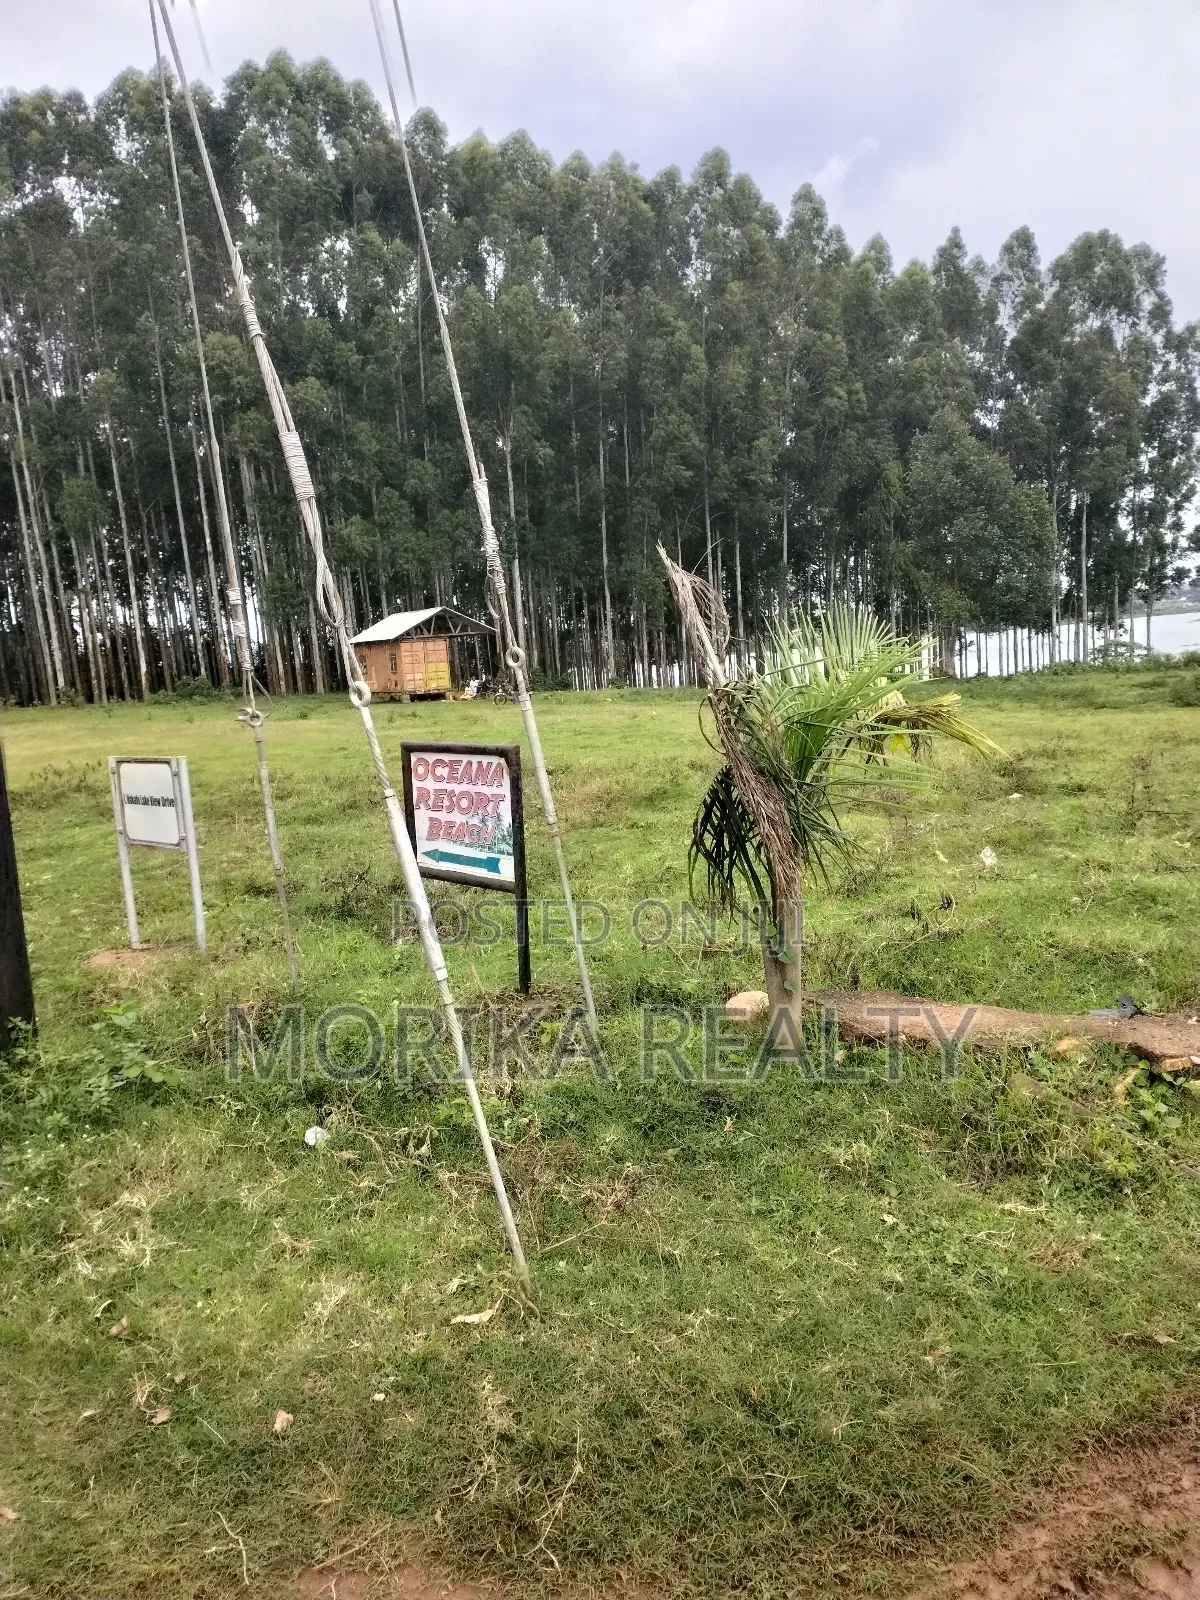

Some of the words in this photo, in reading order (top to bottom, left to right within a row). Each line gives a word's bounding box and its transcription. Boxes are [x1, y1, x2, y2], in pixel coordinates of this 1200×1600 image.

[412, 757, 504, 787] OCEANA
[149, 796, 161, 807] View
[161, 796, 175, 807] Drive
[414, 787, 505, 818] RESORT
[426, 816, 496, 846] BEACH
